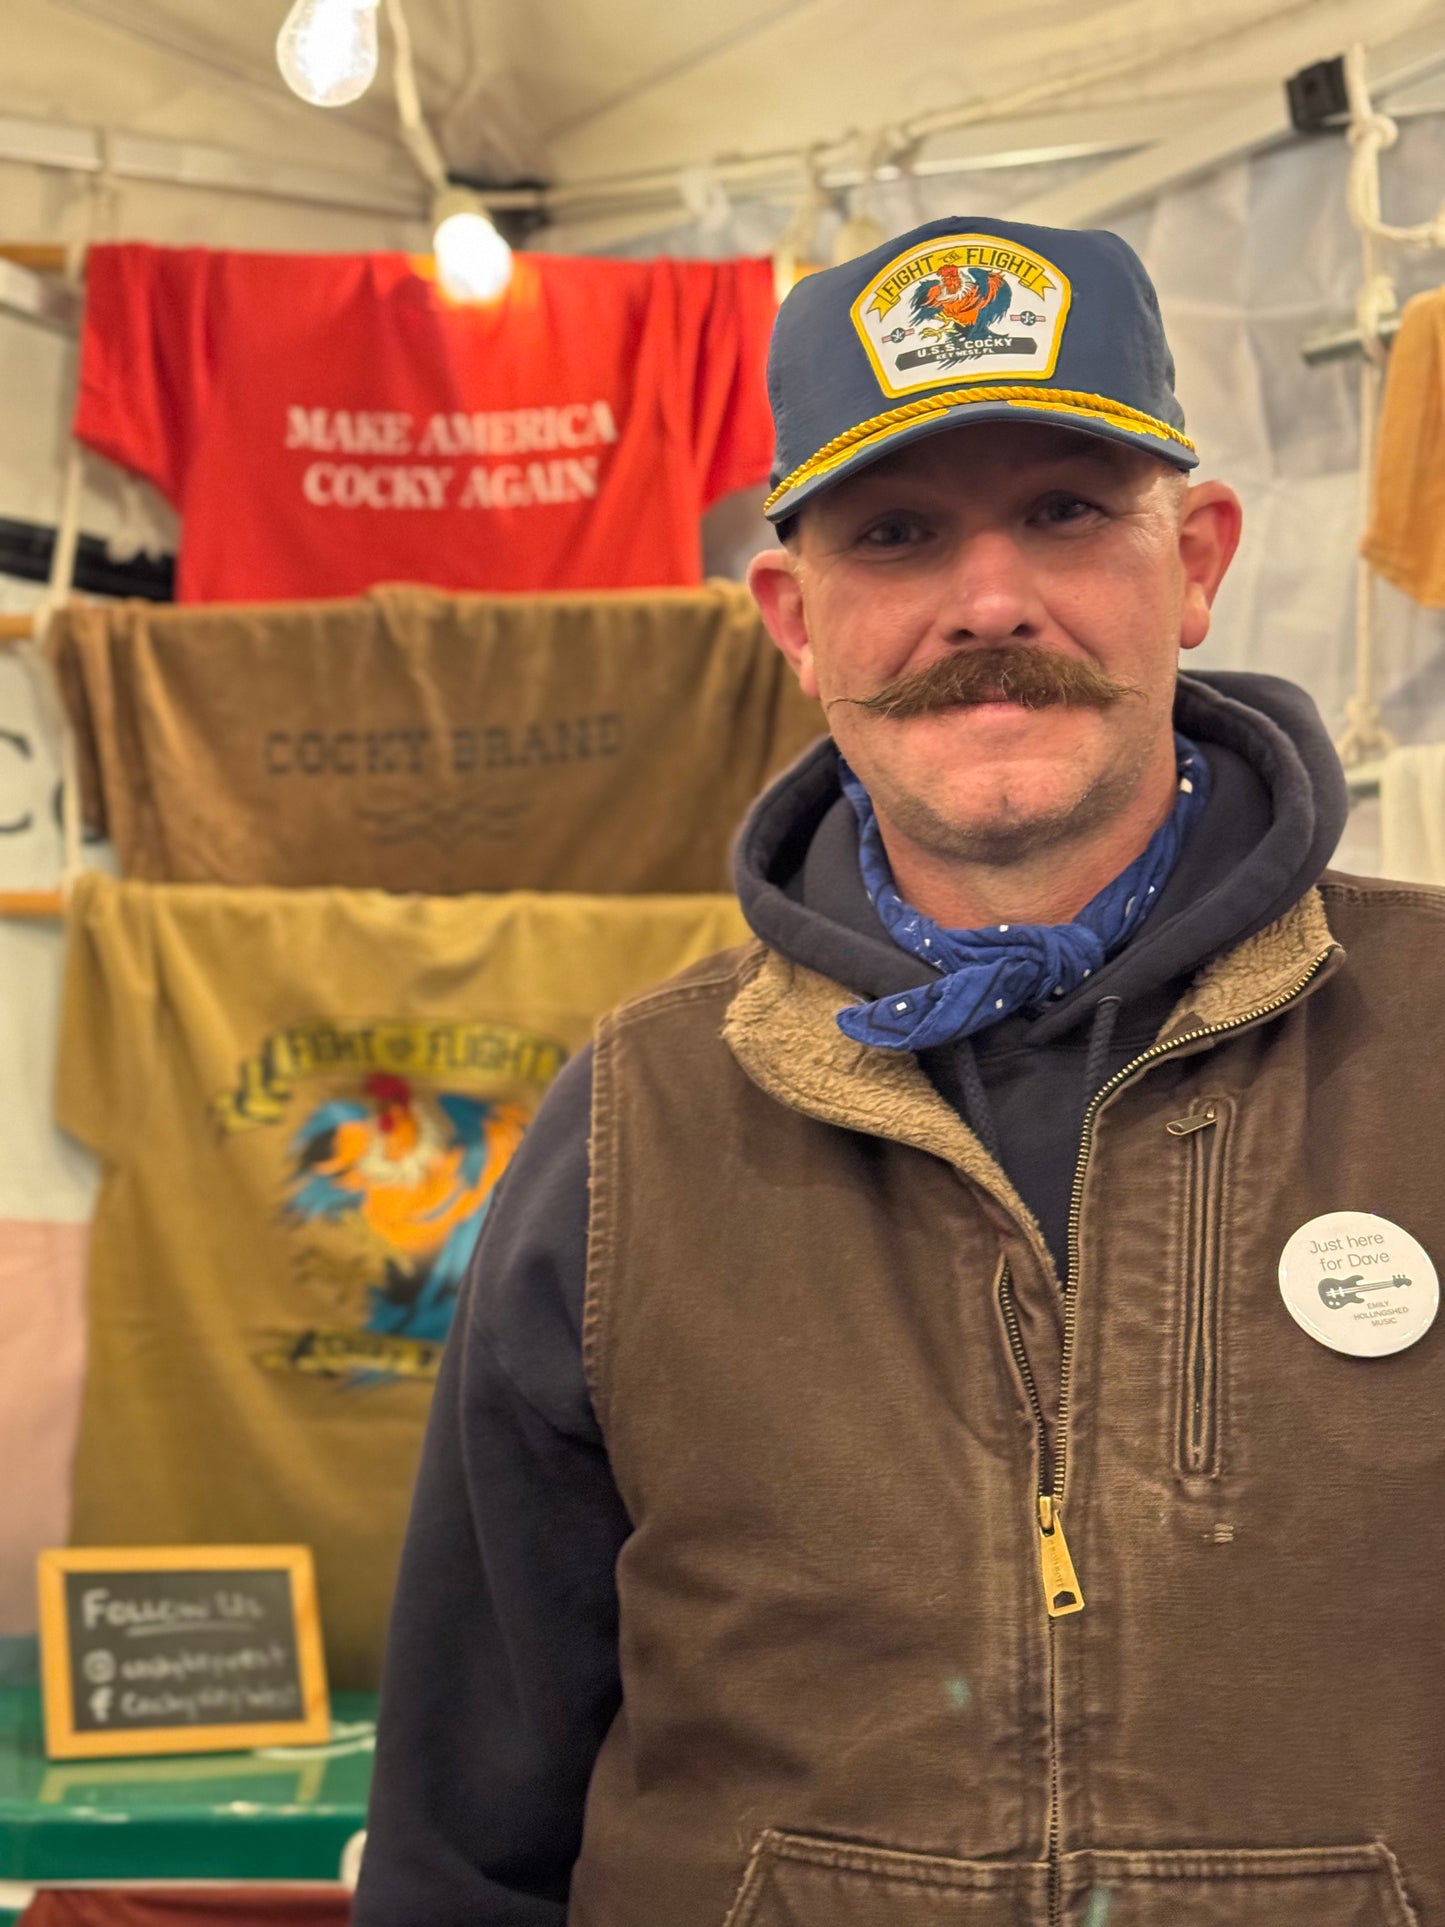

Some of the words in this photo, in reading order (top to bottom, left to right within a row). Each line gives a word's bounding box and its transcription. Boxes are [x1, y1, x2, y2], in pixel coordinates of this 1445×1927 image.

[882, 255, 935, 297] FIGHT
[966, 248, 1038, 279] FLIGHT
[917, 343, 960, 358] U.S.S.
[964, 338, 1013, 349] COCKY
[284, 405, 412, 454] MAKE
[417, 400, 619, 456] AMERICA
[302, 461, 454, 509] COCKY
[459, 455, 598, 509] AGAIN
[264, 728, 430, 775] COCKY
[450, 712, 622, 773] BRAND
[1309, 1237, 1343, 1254] Just
[1346, 1233, 1384, 1248] here
[1320, 1257, 1343, 1272] for
[1347, 1252, 1390, 1268] Dave
[1366, 1301, 1389, 1310] EMILY
[1371, 1318, 1397, 1327] MUSIC
